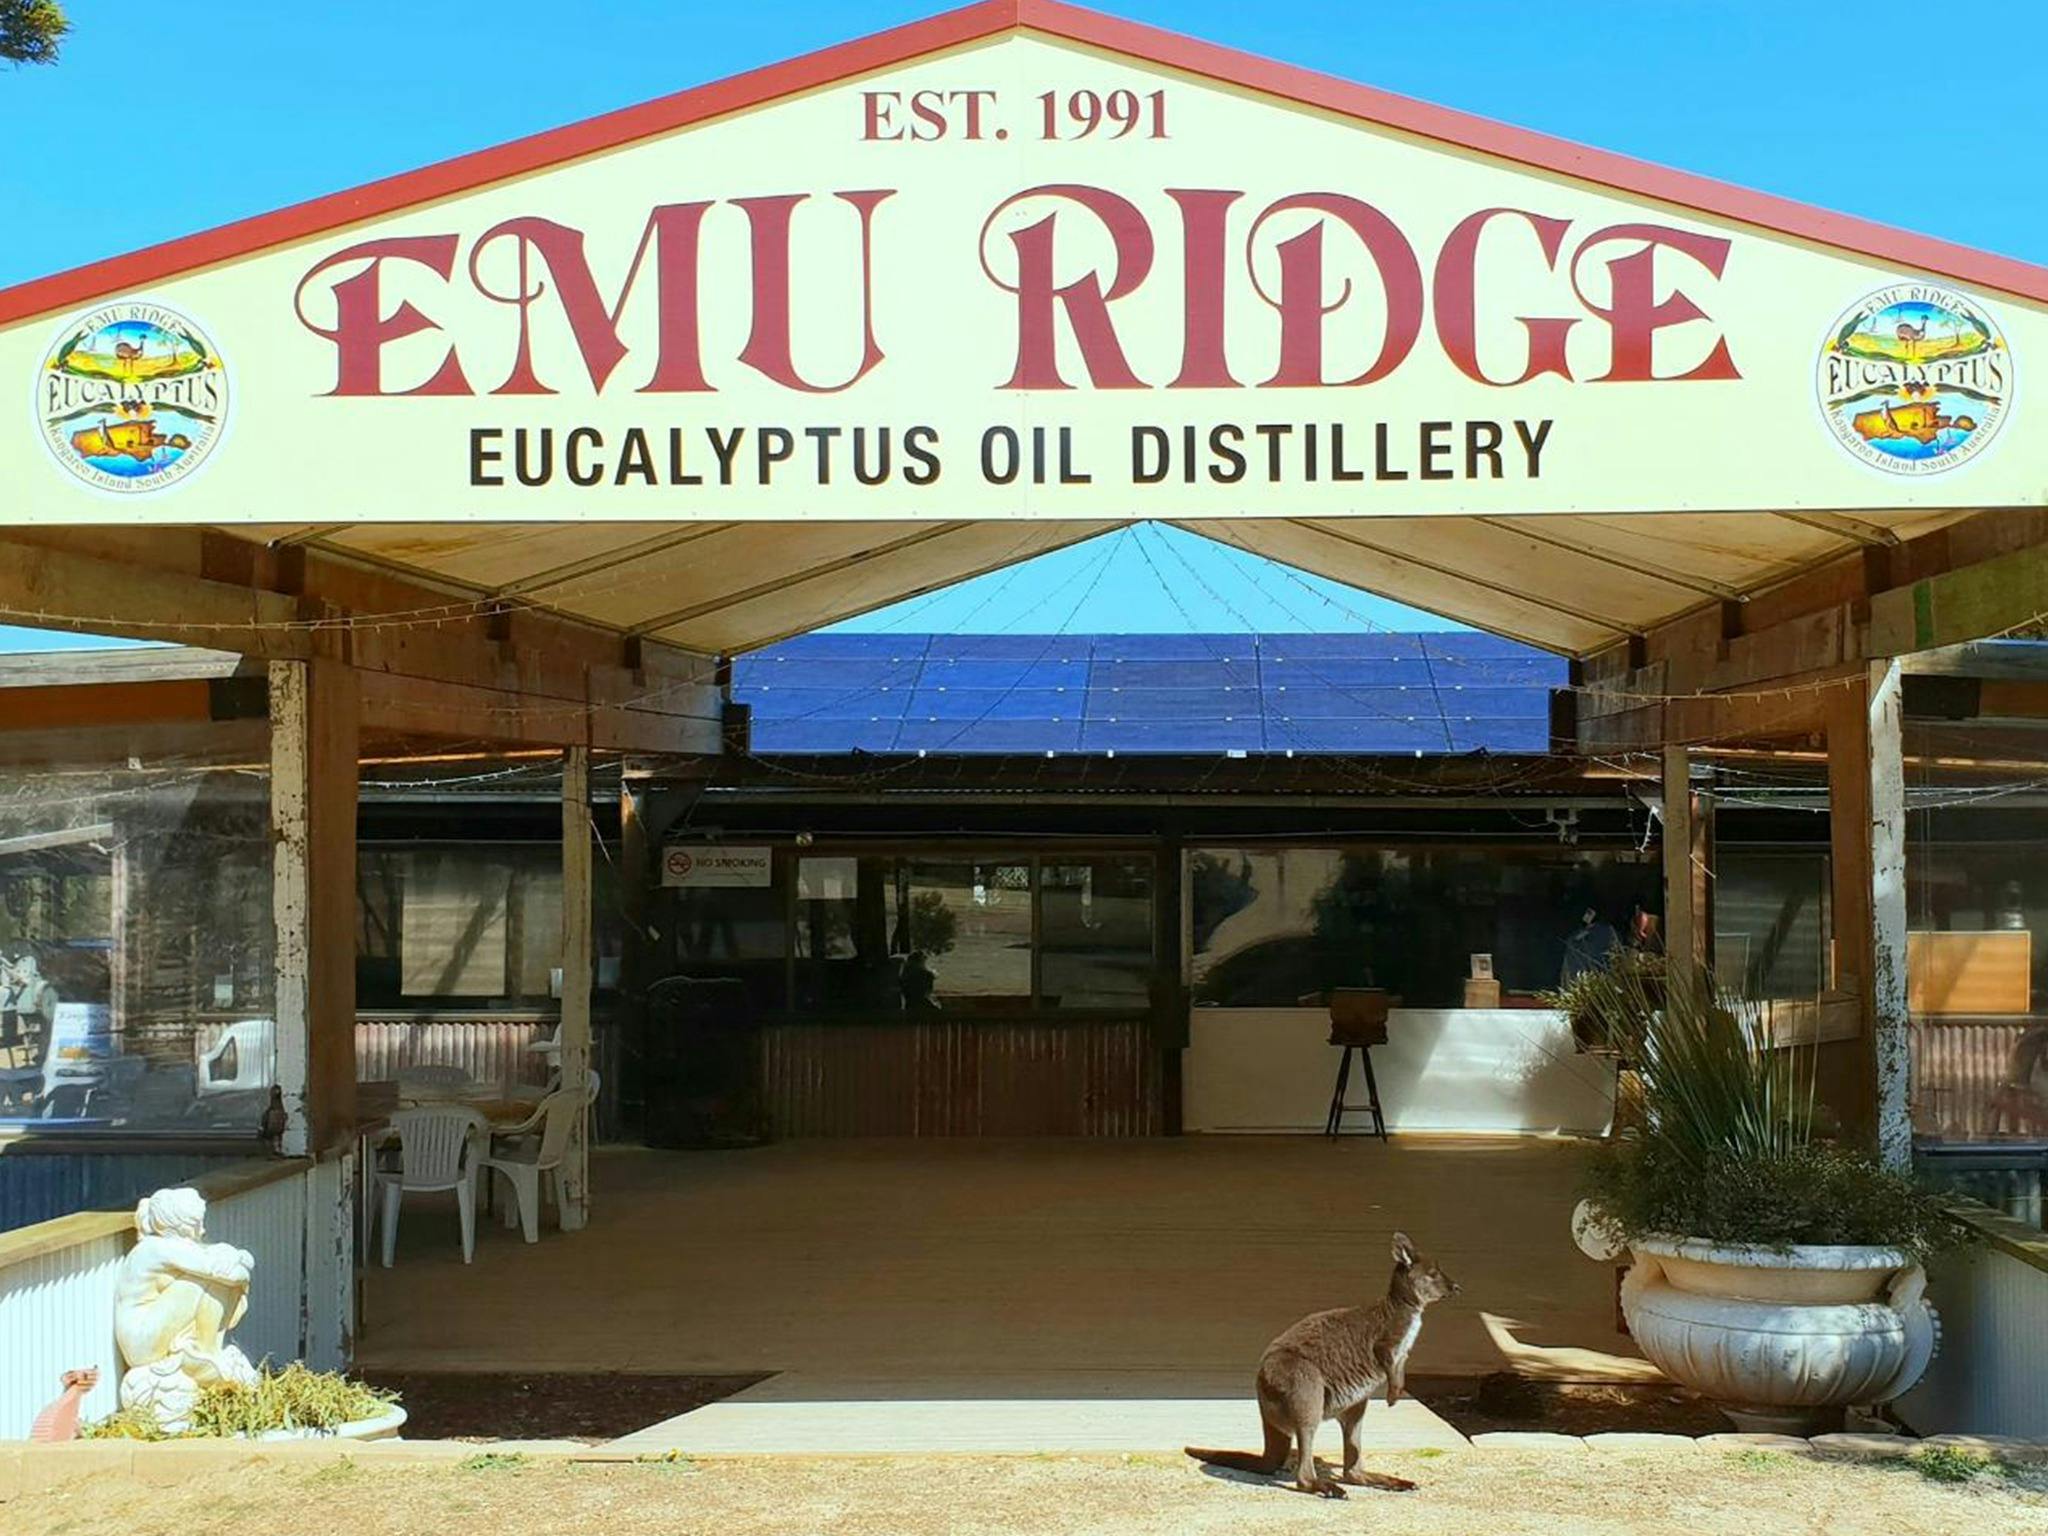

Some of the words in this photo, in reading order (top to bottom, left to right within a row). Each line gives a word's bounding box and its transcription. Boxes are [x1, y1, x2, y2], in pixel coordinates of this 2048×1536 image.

[862, 91, 1008, 141] EST.
[1036, 89, 1170, 140] 1991
[294, 188, 897, 397] EMU
[978, 183, 1743, 390] RIDGE
[1910, 287, 1964, 314] RIDGE
[129, 305, 181, 333] RIDGE
[46, 371, 218, 414] EUCALYPTUS
[1827, 352, 2003, 396] EUCALYPTUS
[470, 426, 942, 487] EUCALYPTUS
[981, 425, 1092, 485] OIL
[1132, 419, 1554, 484] DISTILLERY
[695, 857, 713, 868] NO
[714, 857, 767, 868] SMOKING
